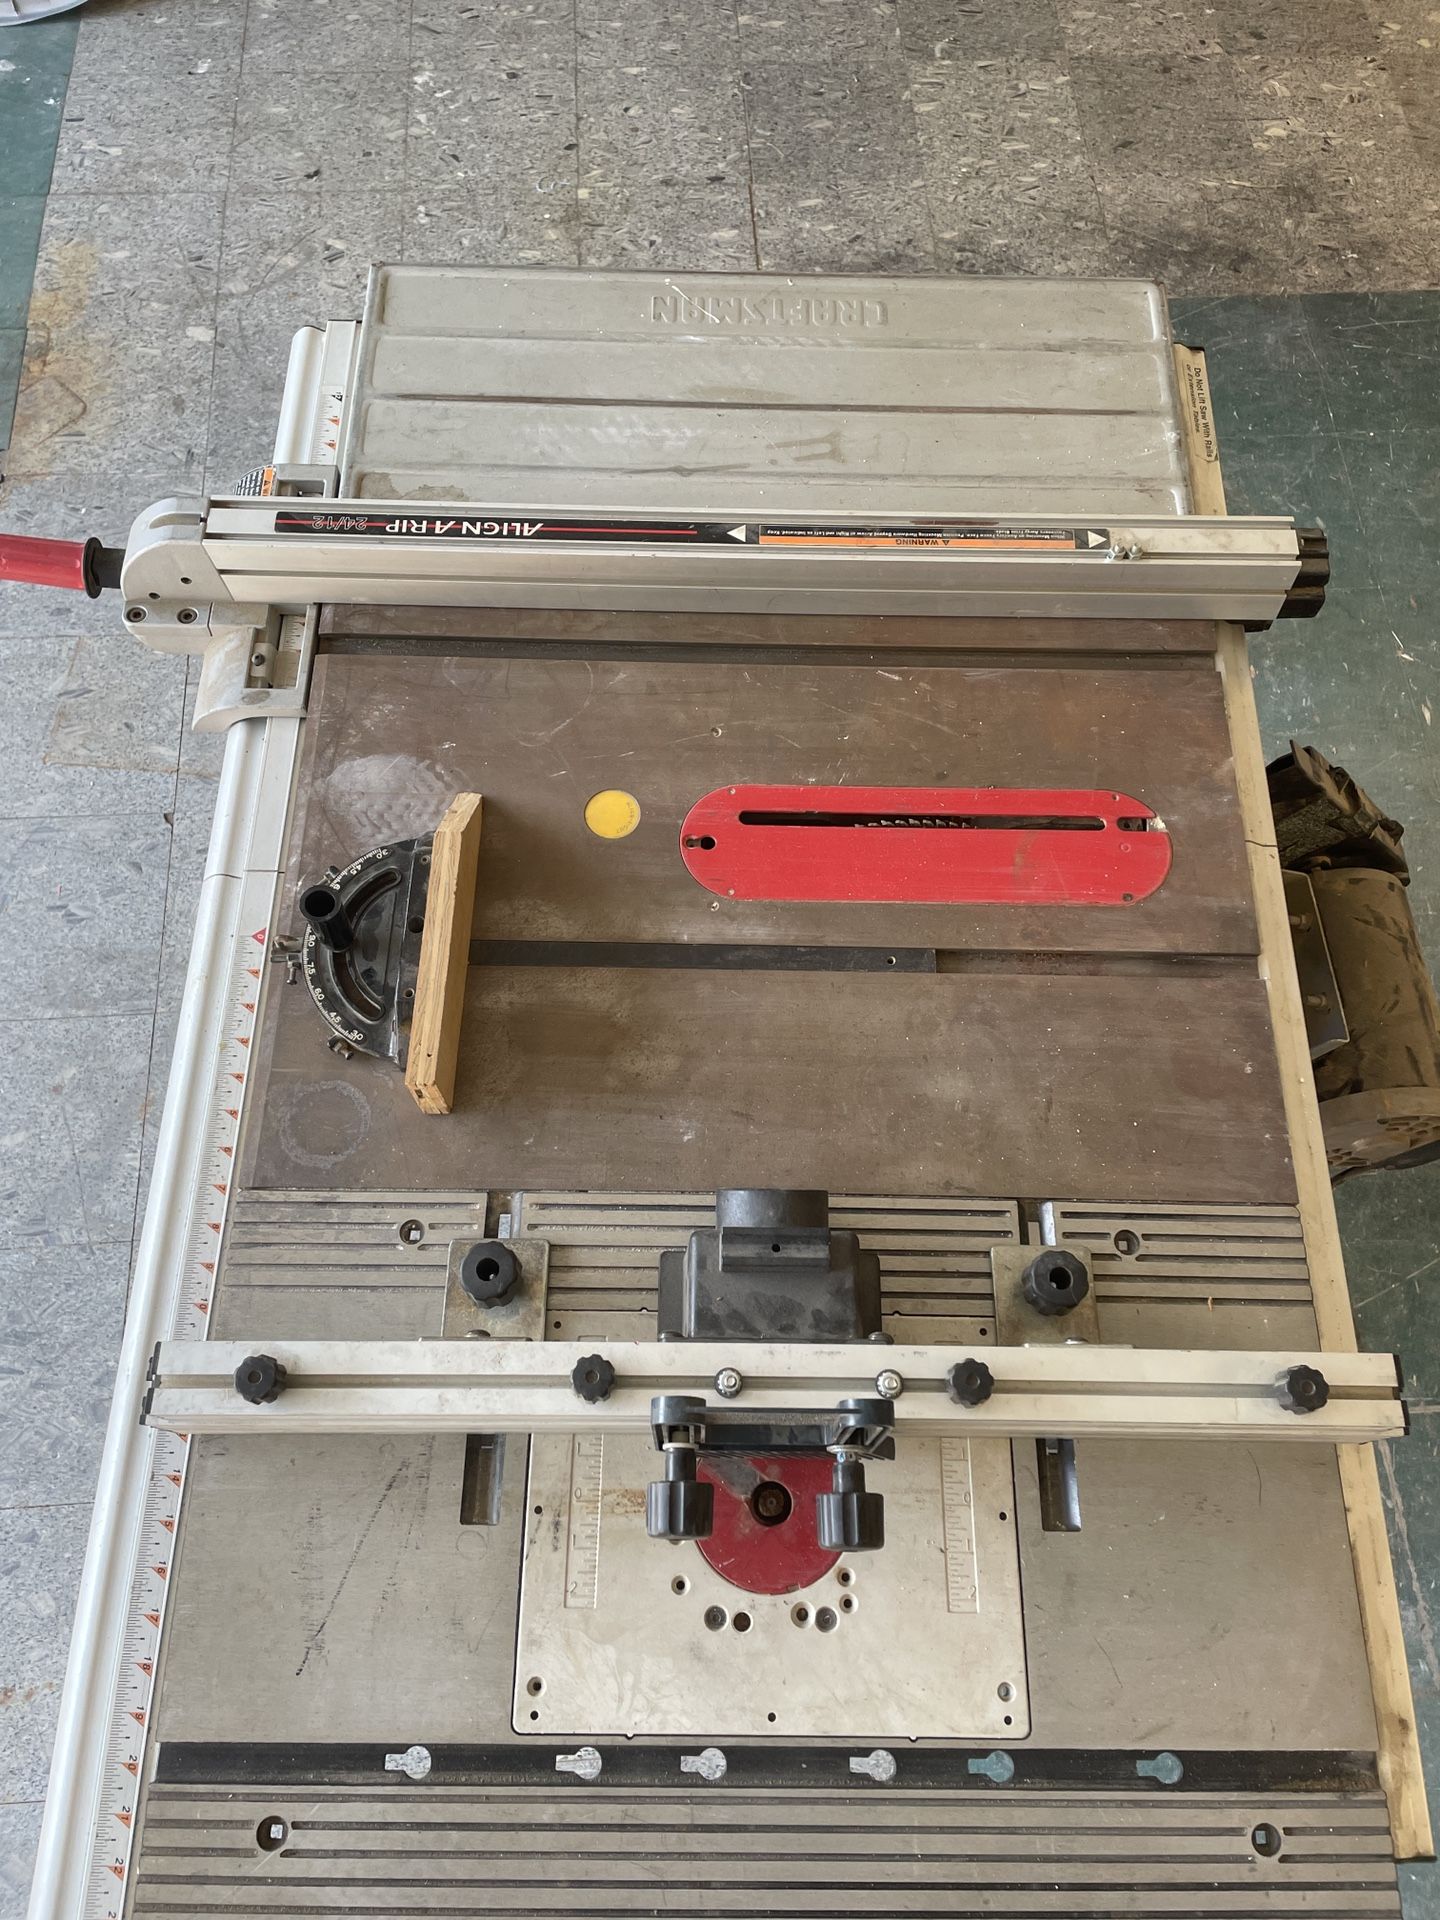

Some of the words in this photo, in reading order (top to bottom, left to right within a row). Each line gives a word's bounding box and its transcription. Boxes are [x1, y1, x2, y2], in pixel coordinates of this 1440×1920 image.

[650, 295, 889, 329] CRAFTSMAN
[1194, 367, 1202, 377] Do
[1187, 373, 1198, 408] Extension
[1196, 378, 1204, 391] Not
[1198, 393, 1206, 404] Lift
[1200, 406, 1208, 420] Saw
[1202, 422, 1211, 438] With
[1204, 440, 1213, 457] Rails
[311, 516, 368, 531] 24/12
[385, 519, 427, 534] RIP
[434, 520, 456, 535] A
[461, 521, 544, 537] ALIGN
[895, 538, 939, 546] WARNING
[376, 848, 389, 860] 30
[308, 964, 316, 976] 75
[315, 988, 325, 1001] 60
[330, 1011, 342, 1023] 45
[351, 1029, 364, 1041] 30
[199, 1298, 208, 1309] 10
[171, 1469, 181, 1481] 14
[164, 1514, 174, 1528] 15
[157, 1561, 167, 1575] 16
[150, 1608, 160, 1622] 17
[142, 1656, 152, 1671] 18
[135, 1705, 145, 1720] 19
[128, 1754, 138, 1771] 20
[120, 1805, 131, 1821] 21
[113, 1857, 124, 1874] 22
